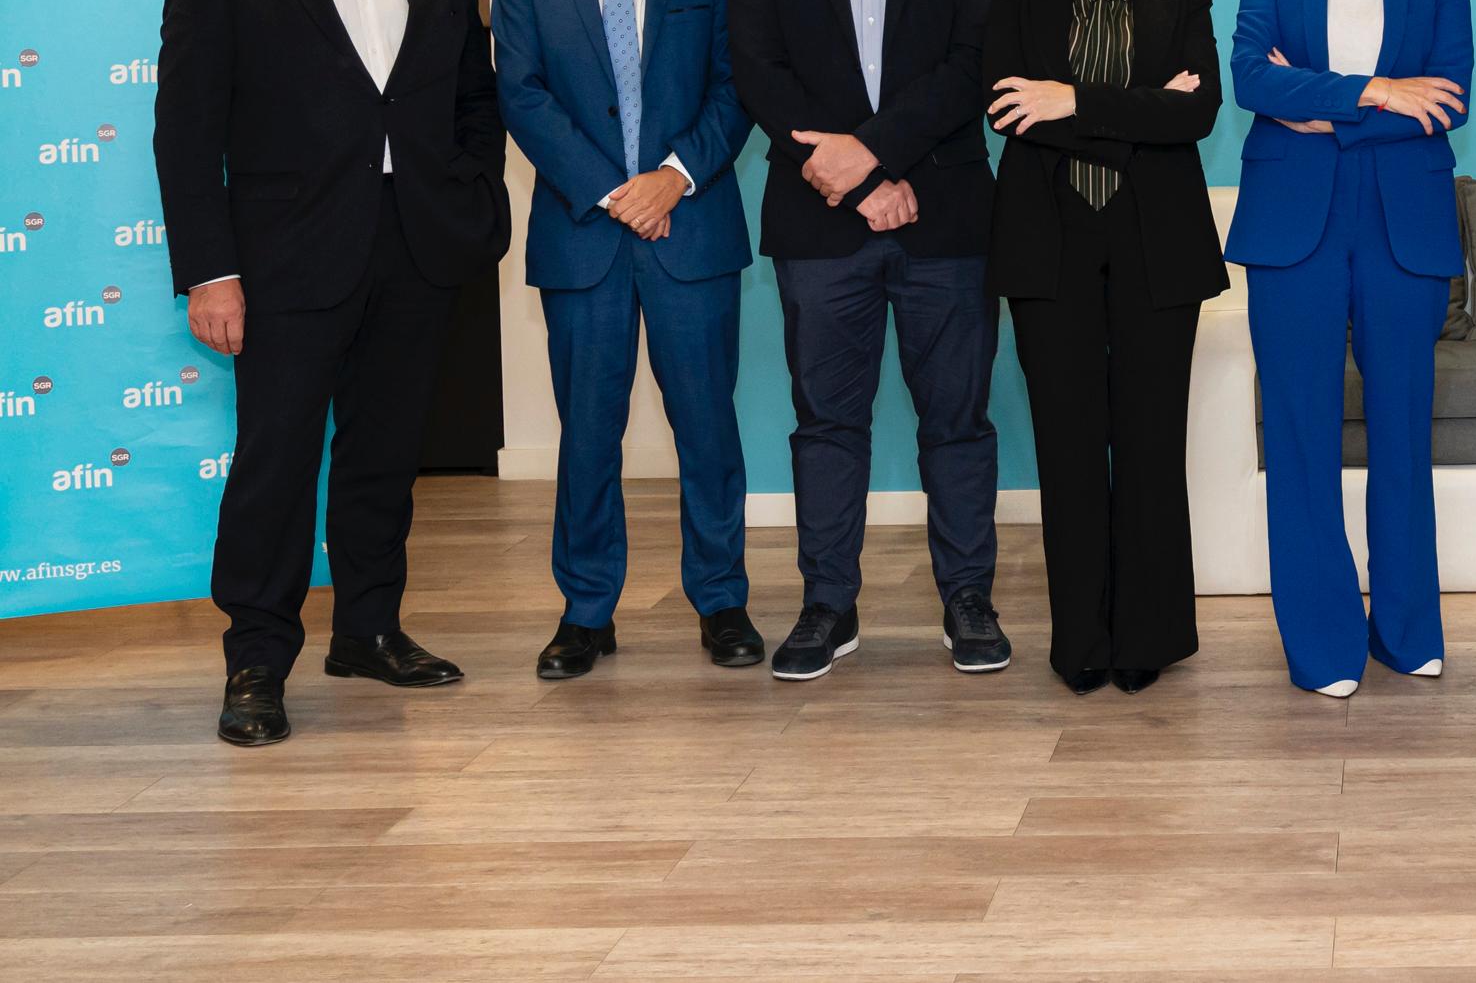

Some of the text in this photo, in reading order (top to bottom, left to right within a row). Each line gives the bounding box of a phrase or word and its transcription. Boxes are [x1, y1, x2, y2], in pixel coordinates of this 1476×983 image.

[20, 54, 38, 63] SGR
[39, 129, 116, 165] afín SGR
[25, 218, 43, 226] SGR
[43, 291, 120, 328] afín SGR
[33, 381, 52, 390] SGR
[123, 371, 199, 409] afín SGR
[52, 453, 129, 492] afín SGR
[0, 559, 122, 583] w.afinsgr.es
